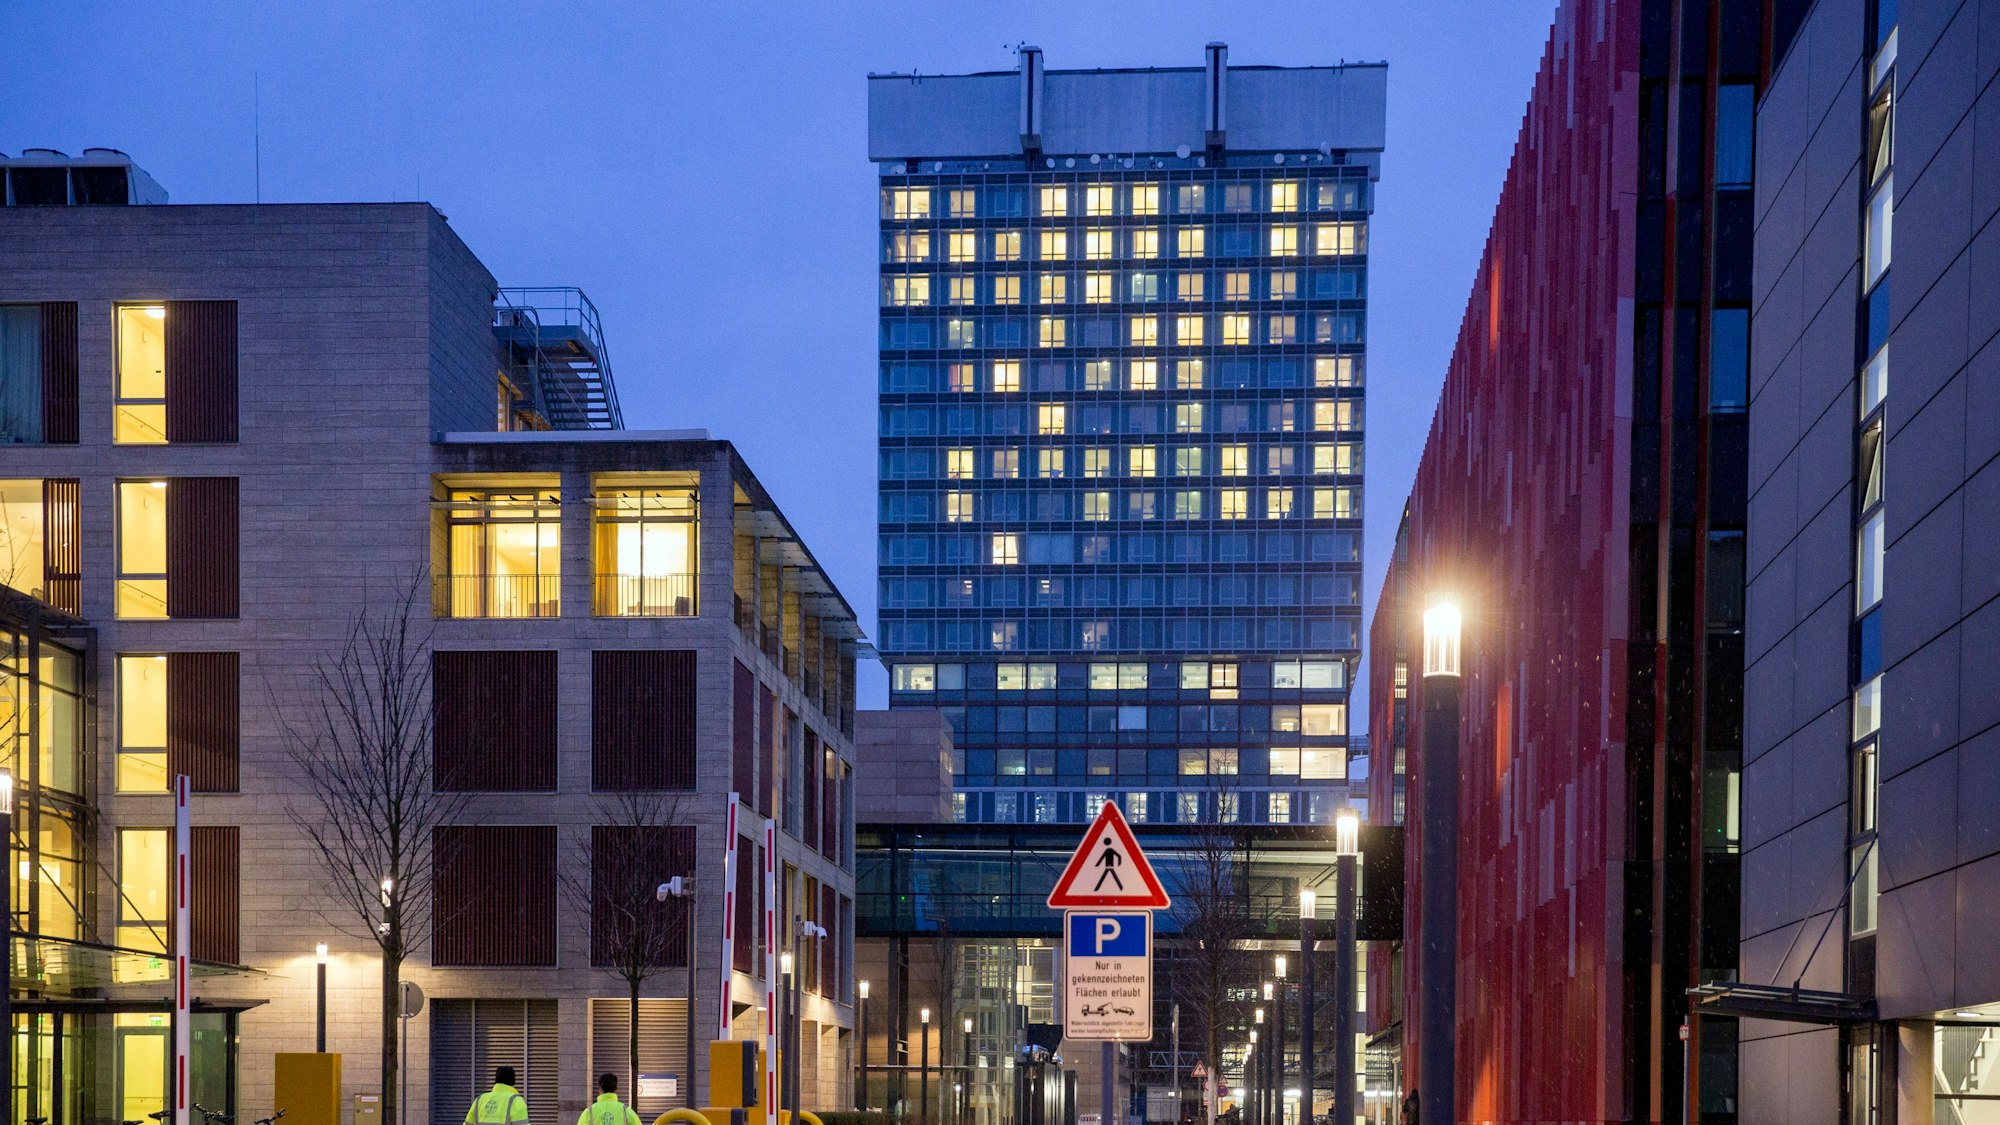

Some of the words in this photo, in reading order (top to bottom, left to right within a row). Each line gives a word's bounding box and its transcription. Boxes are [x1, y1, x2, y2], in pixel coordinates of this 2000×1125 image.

[1096, 918, 1121, 954] P
[1095, 960, 1110, 970] Nur
[1114, 960, 1121, 970] in
[1072, 974, 1145, 985] gekennzeichneten
[1076, 987, 1108, 997] Flächen
[1111, 987, 1141, 997] erlaubt
